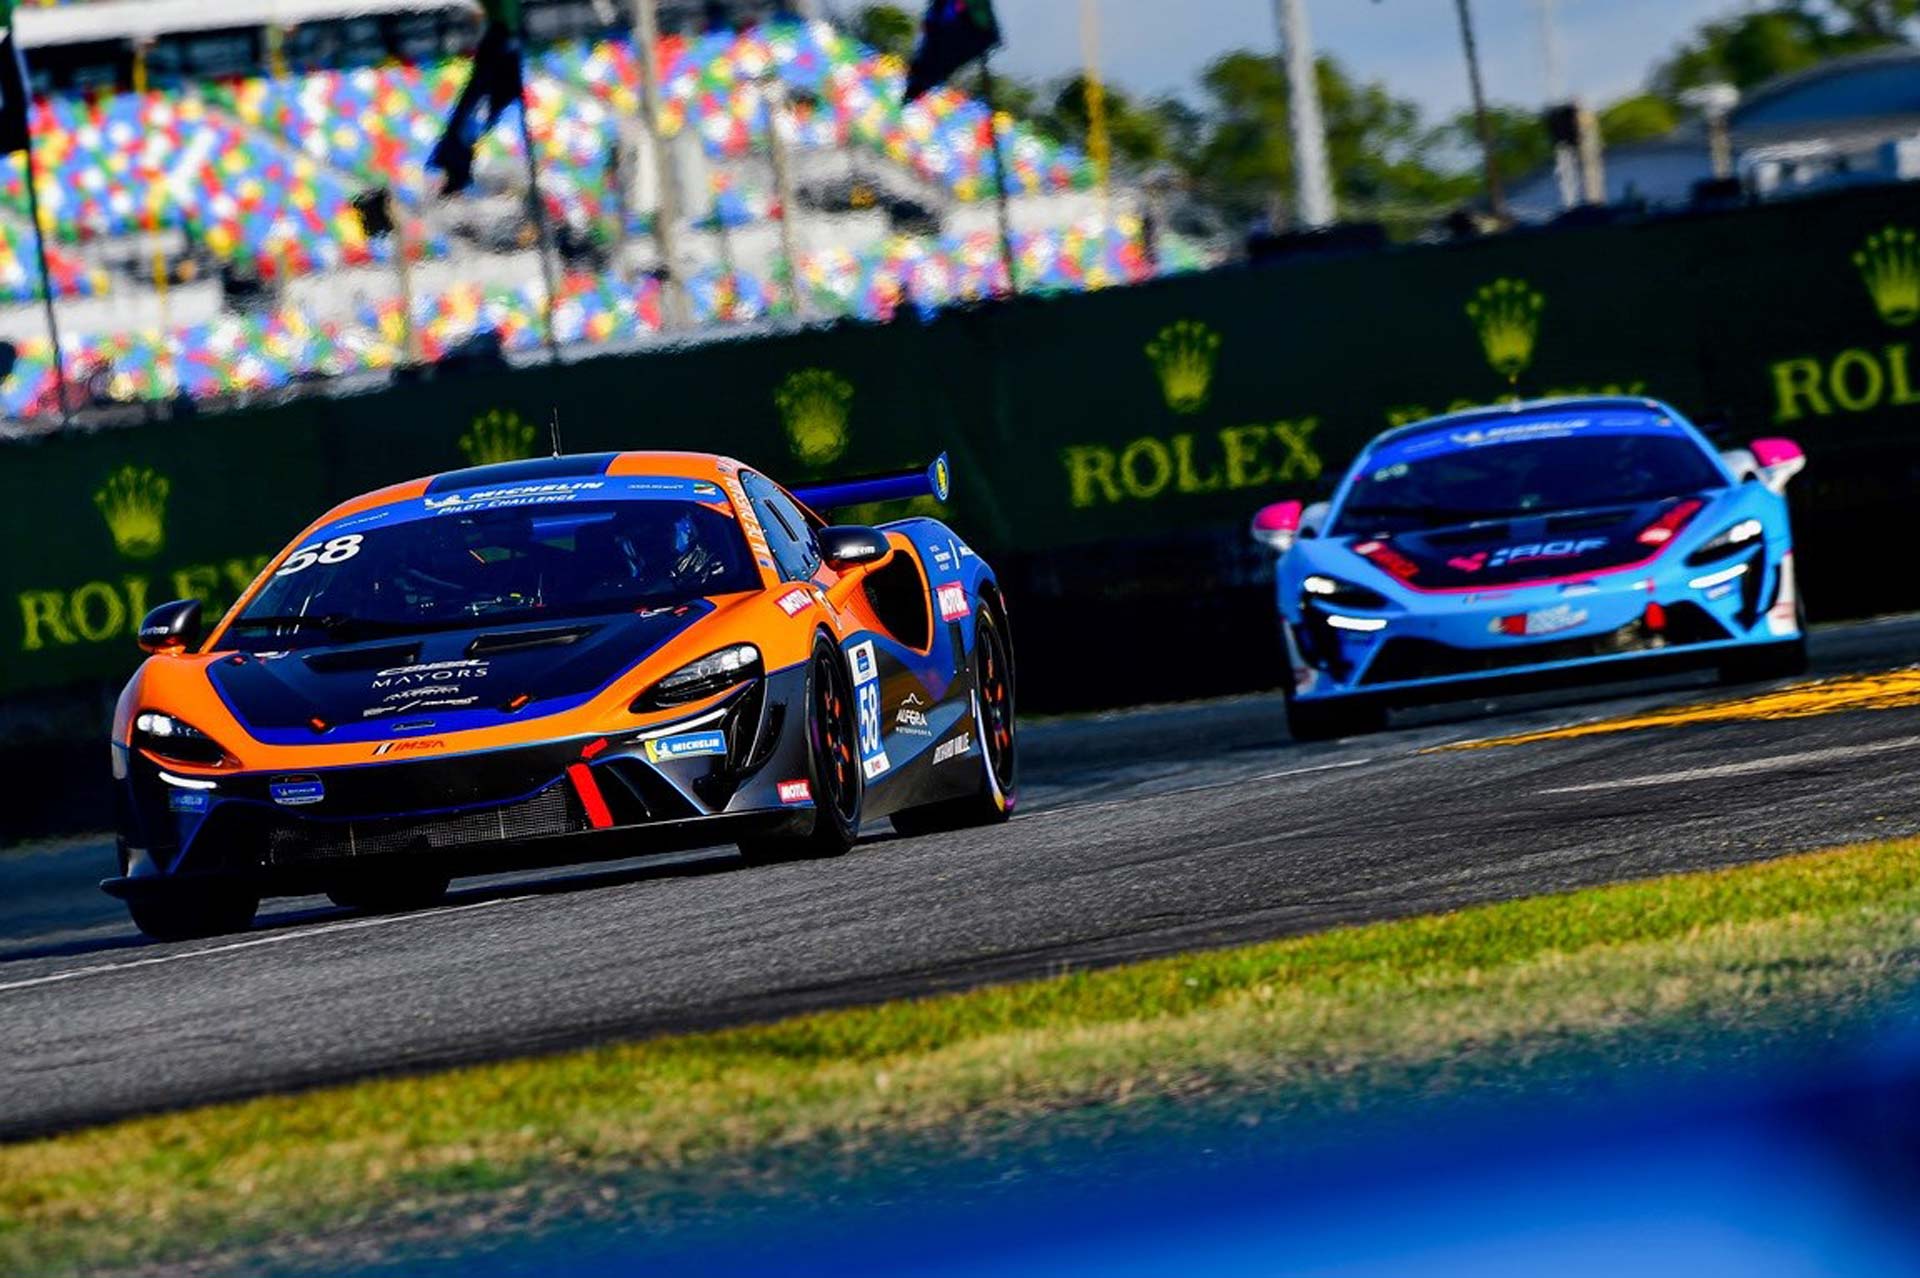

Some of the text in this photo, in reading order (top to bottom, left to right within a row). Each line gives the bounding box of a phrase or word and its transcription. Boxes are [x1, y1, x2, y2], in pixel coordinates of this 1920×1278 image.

[1063, 417, 1322, 507] ROLEX
[469, 482, 605, 499] MICHELIN
[437, 494, 577, 514] PILOT CHALLENGE
[275, 534, 364, 576] 58
[372, 668, 488, 688] MAYORS
[859, 683, 879, 755] 58
[394, 740, 445, 751] IMSA
[672, 738, 720, 752] MICHELIN
[781, 783, 809, 799] MOTUL
